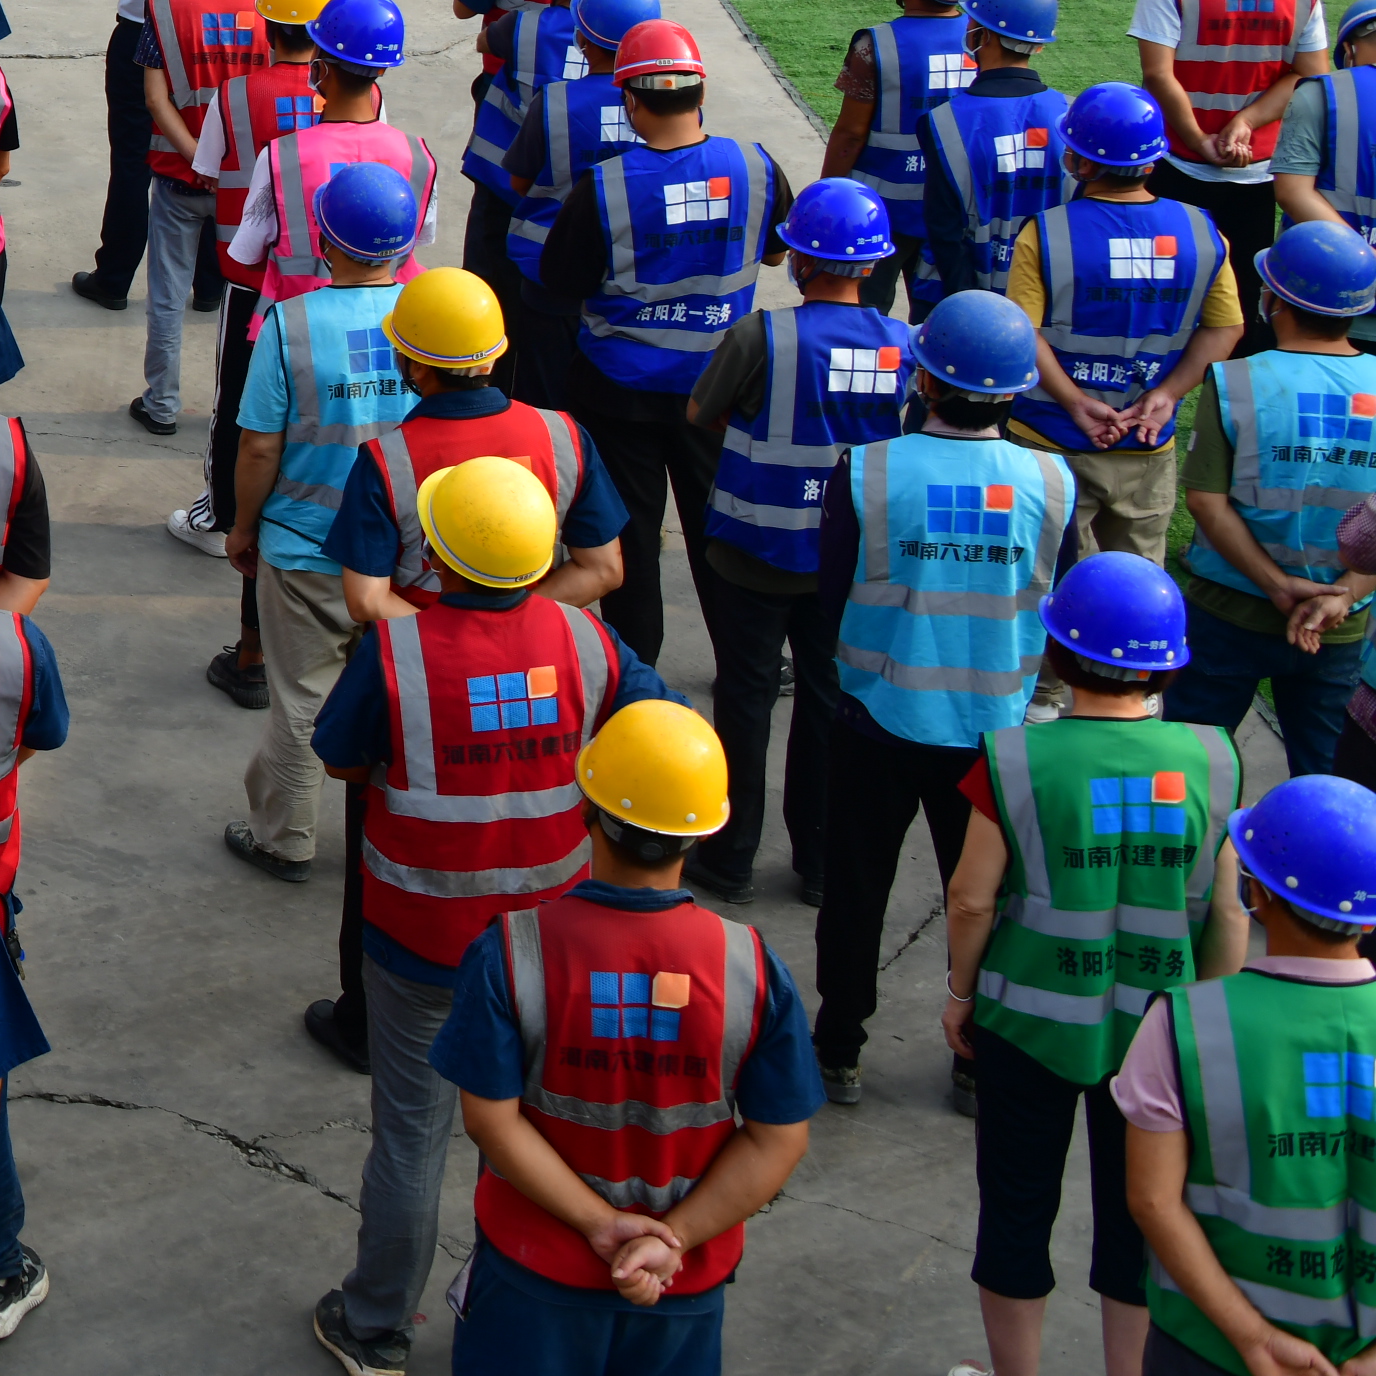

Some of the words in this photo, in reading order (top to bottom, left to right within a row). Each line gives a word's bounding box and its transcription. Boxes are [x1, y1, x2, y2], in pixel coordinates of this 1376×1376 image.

[635, 302, 733, 327] 洛阳龙一劳务
[803, 479, 827, 501] 洛
[898, 539, 1025, 564] 河南六建集团
[1062, 842, 1198, 871] 河南六建集团
[1056, 946, 1186, 979] 洛阳龙一劳务
